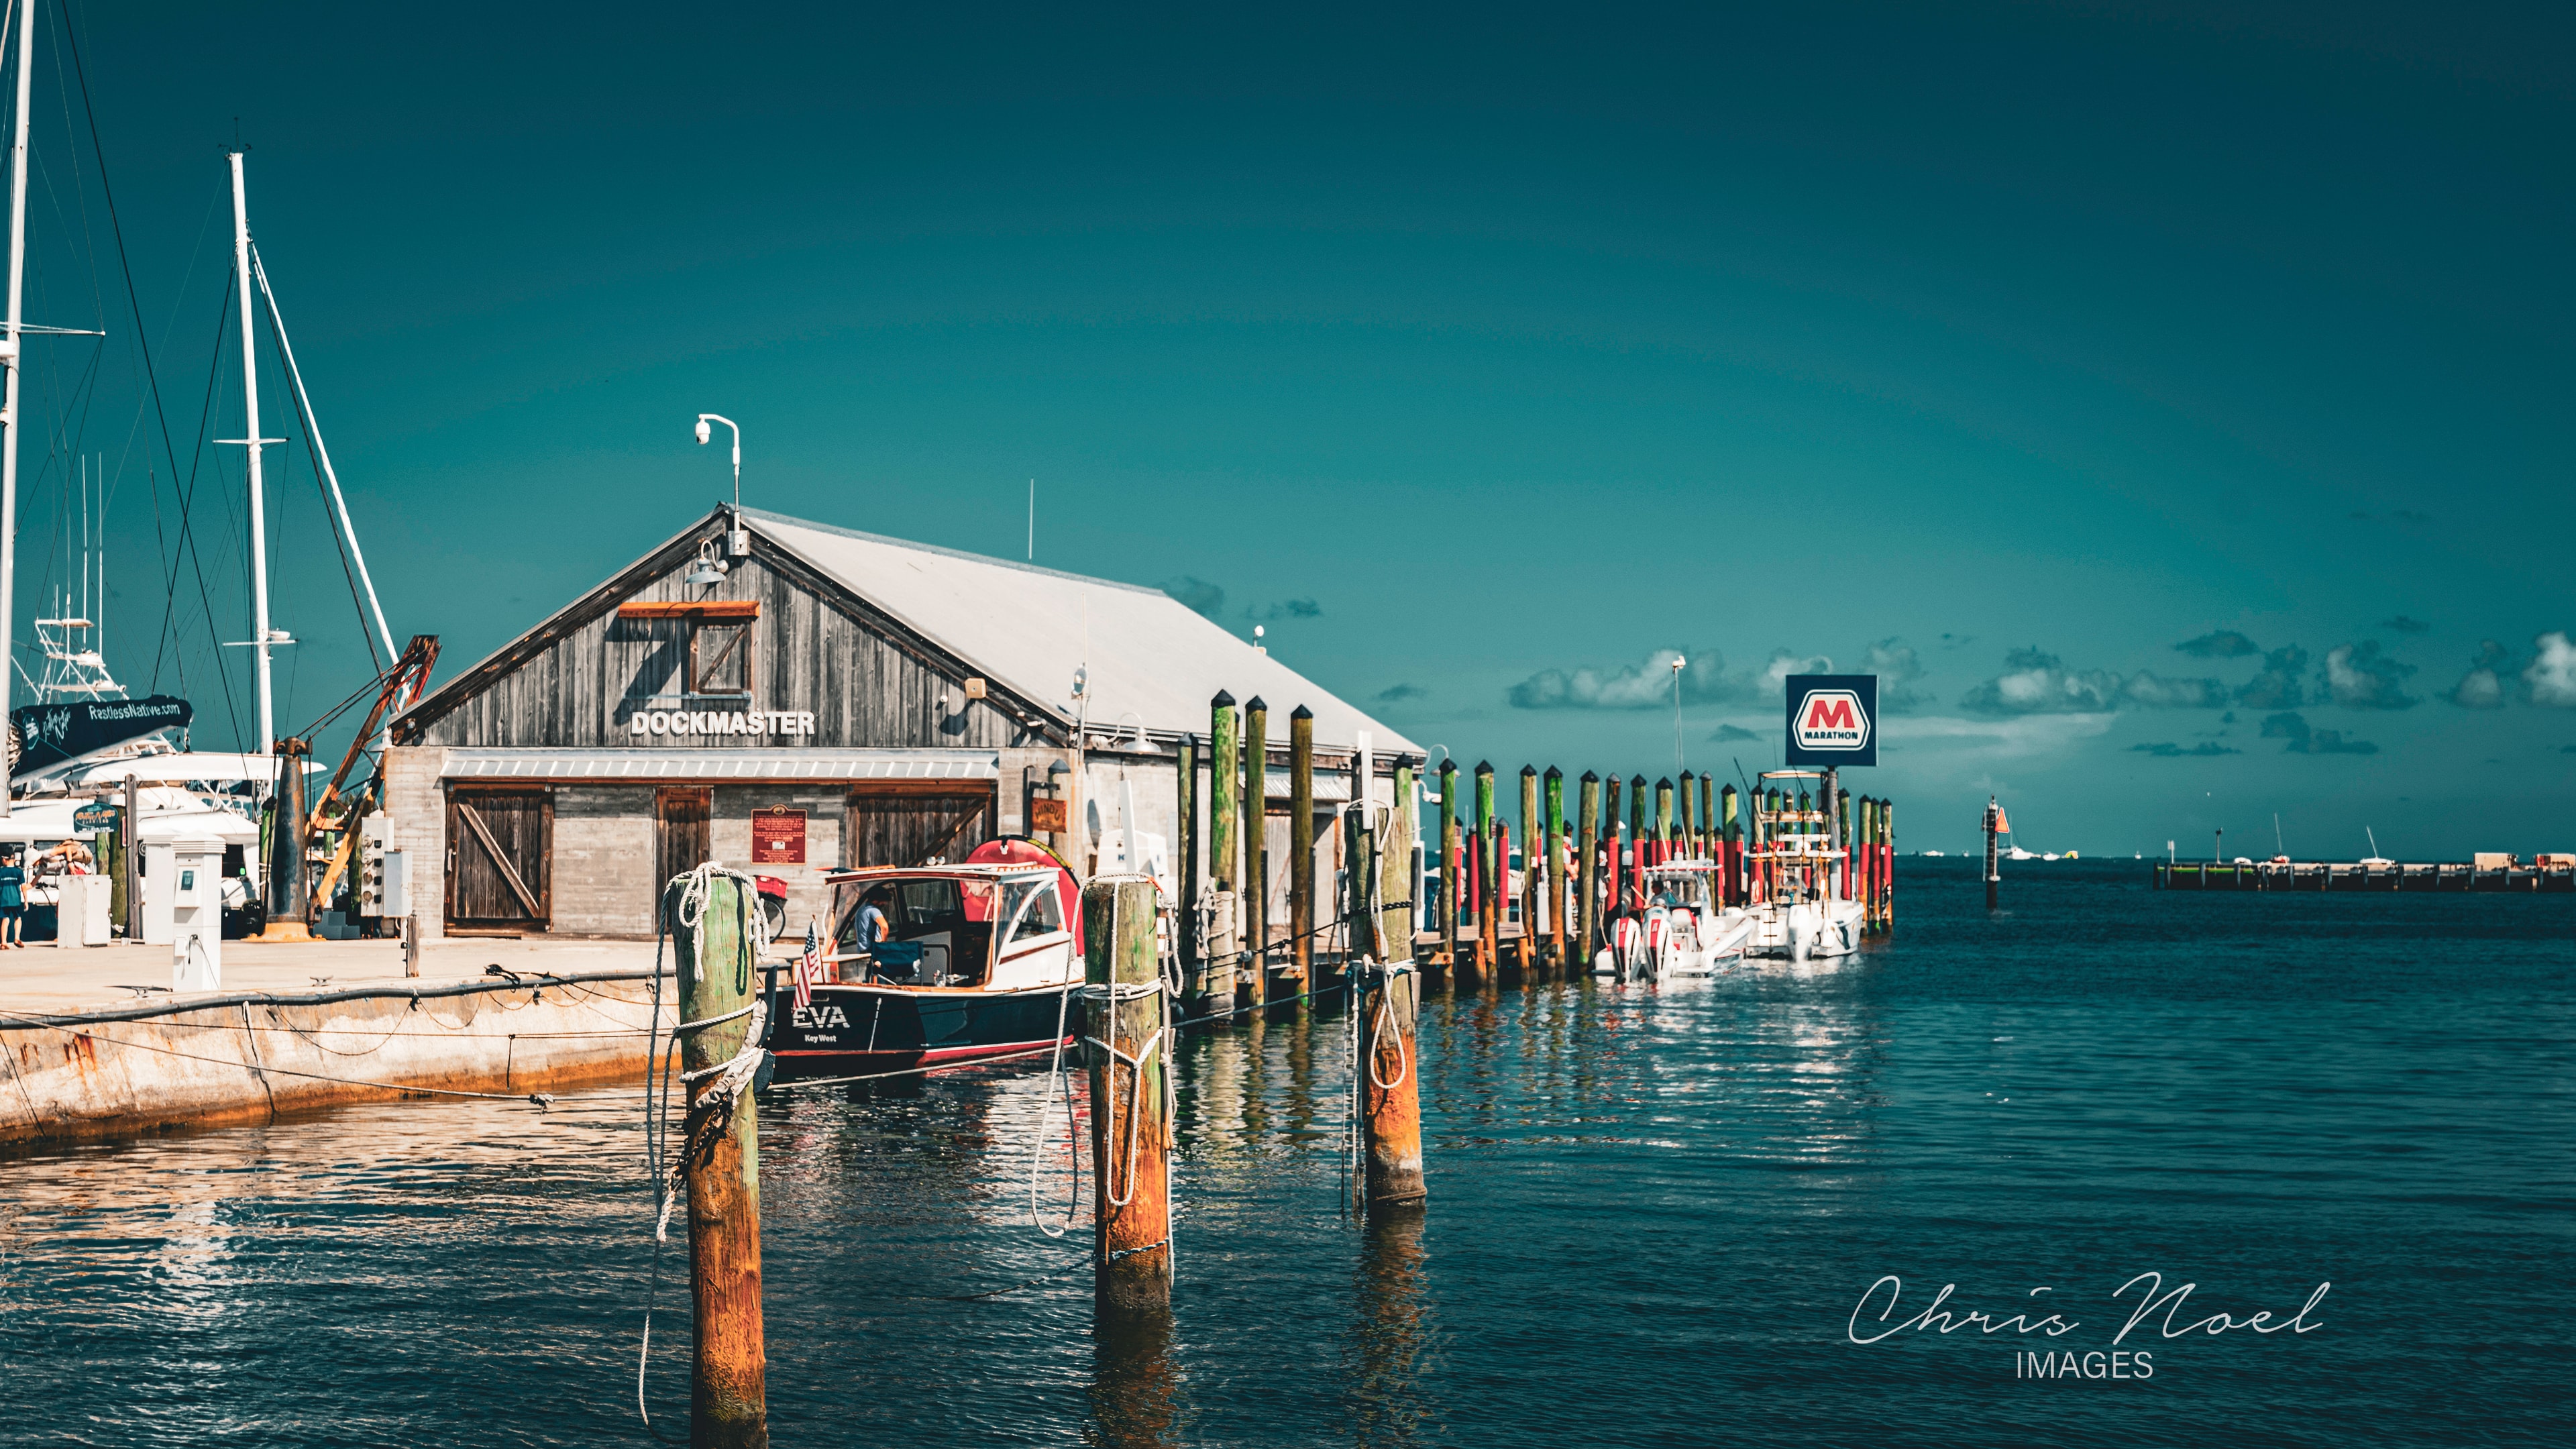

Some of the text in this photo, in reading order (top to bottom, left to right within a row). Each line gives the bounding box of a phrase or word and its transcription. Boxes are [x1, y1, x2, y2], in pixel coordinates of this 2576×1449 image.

[88, 703, 180, 720] RestlessNative.com
[1807, 700, 1856, 728] M
[631, 711, 815, 735] DOCKMASTER
[1804, 731, 1858, 739] MARATHON
[1034, 803, 1061, 821] HINDU
[792, 1006, 851, 1028] EVA
[804, 1034, 837, 1044] Key West
